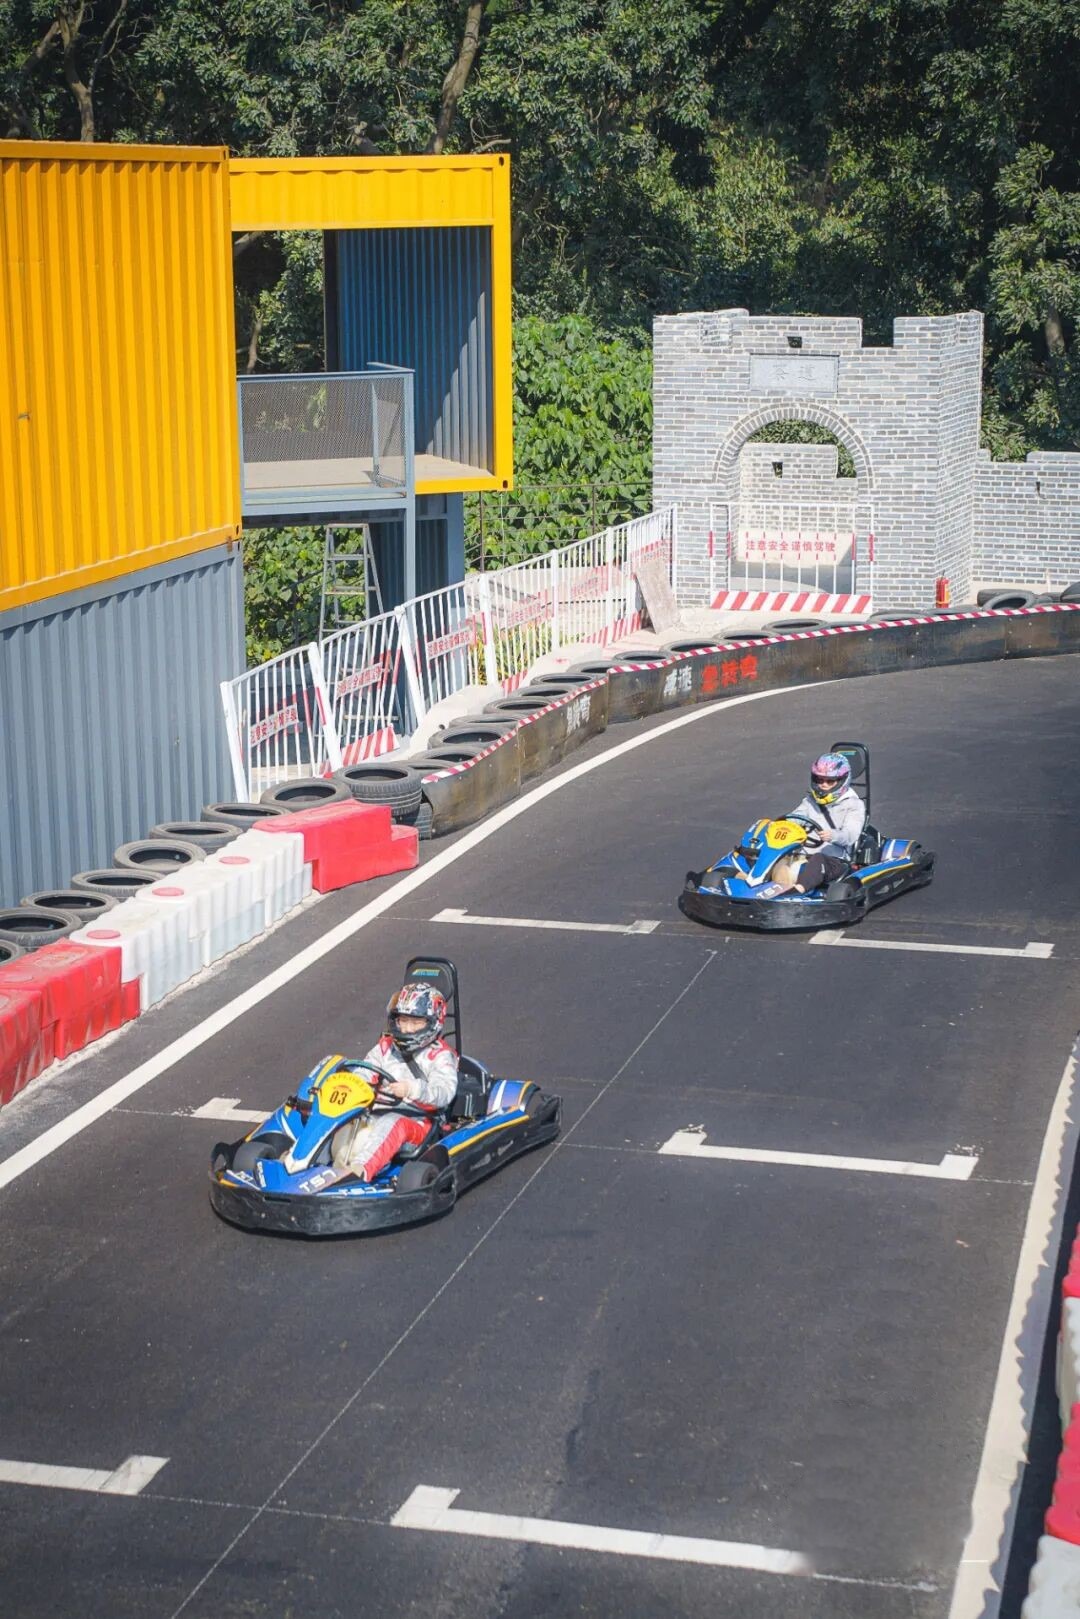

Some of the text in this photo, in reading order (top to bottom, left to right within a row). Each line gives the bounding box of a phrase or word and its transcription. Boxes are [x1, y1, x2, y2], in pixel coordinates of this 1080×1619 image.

[746, 540, 836, 553] 注意安全谨慎驾驶
[774, 830, 788, 840] 06
[329, 1090, 348, 1105] 03
[299, 1169, 337, 1193] TS7
